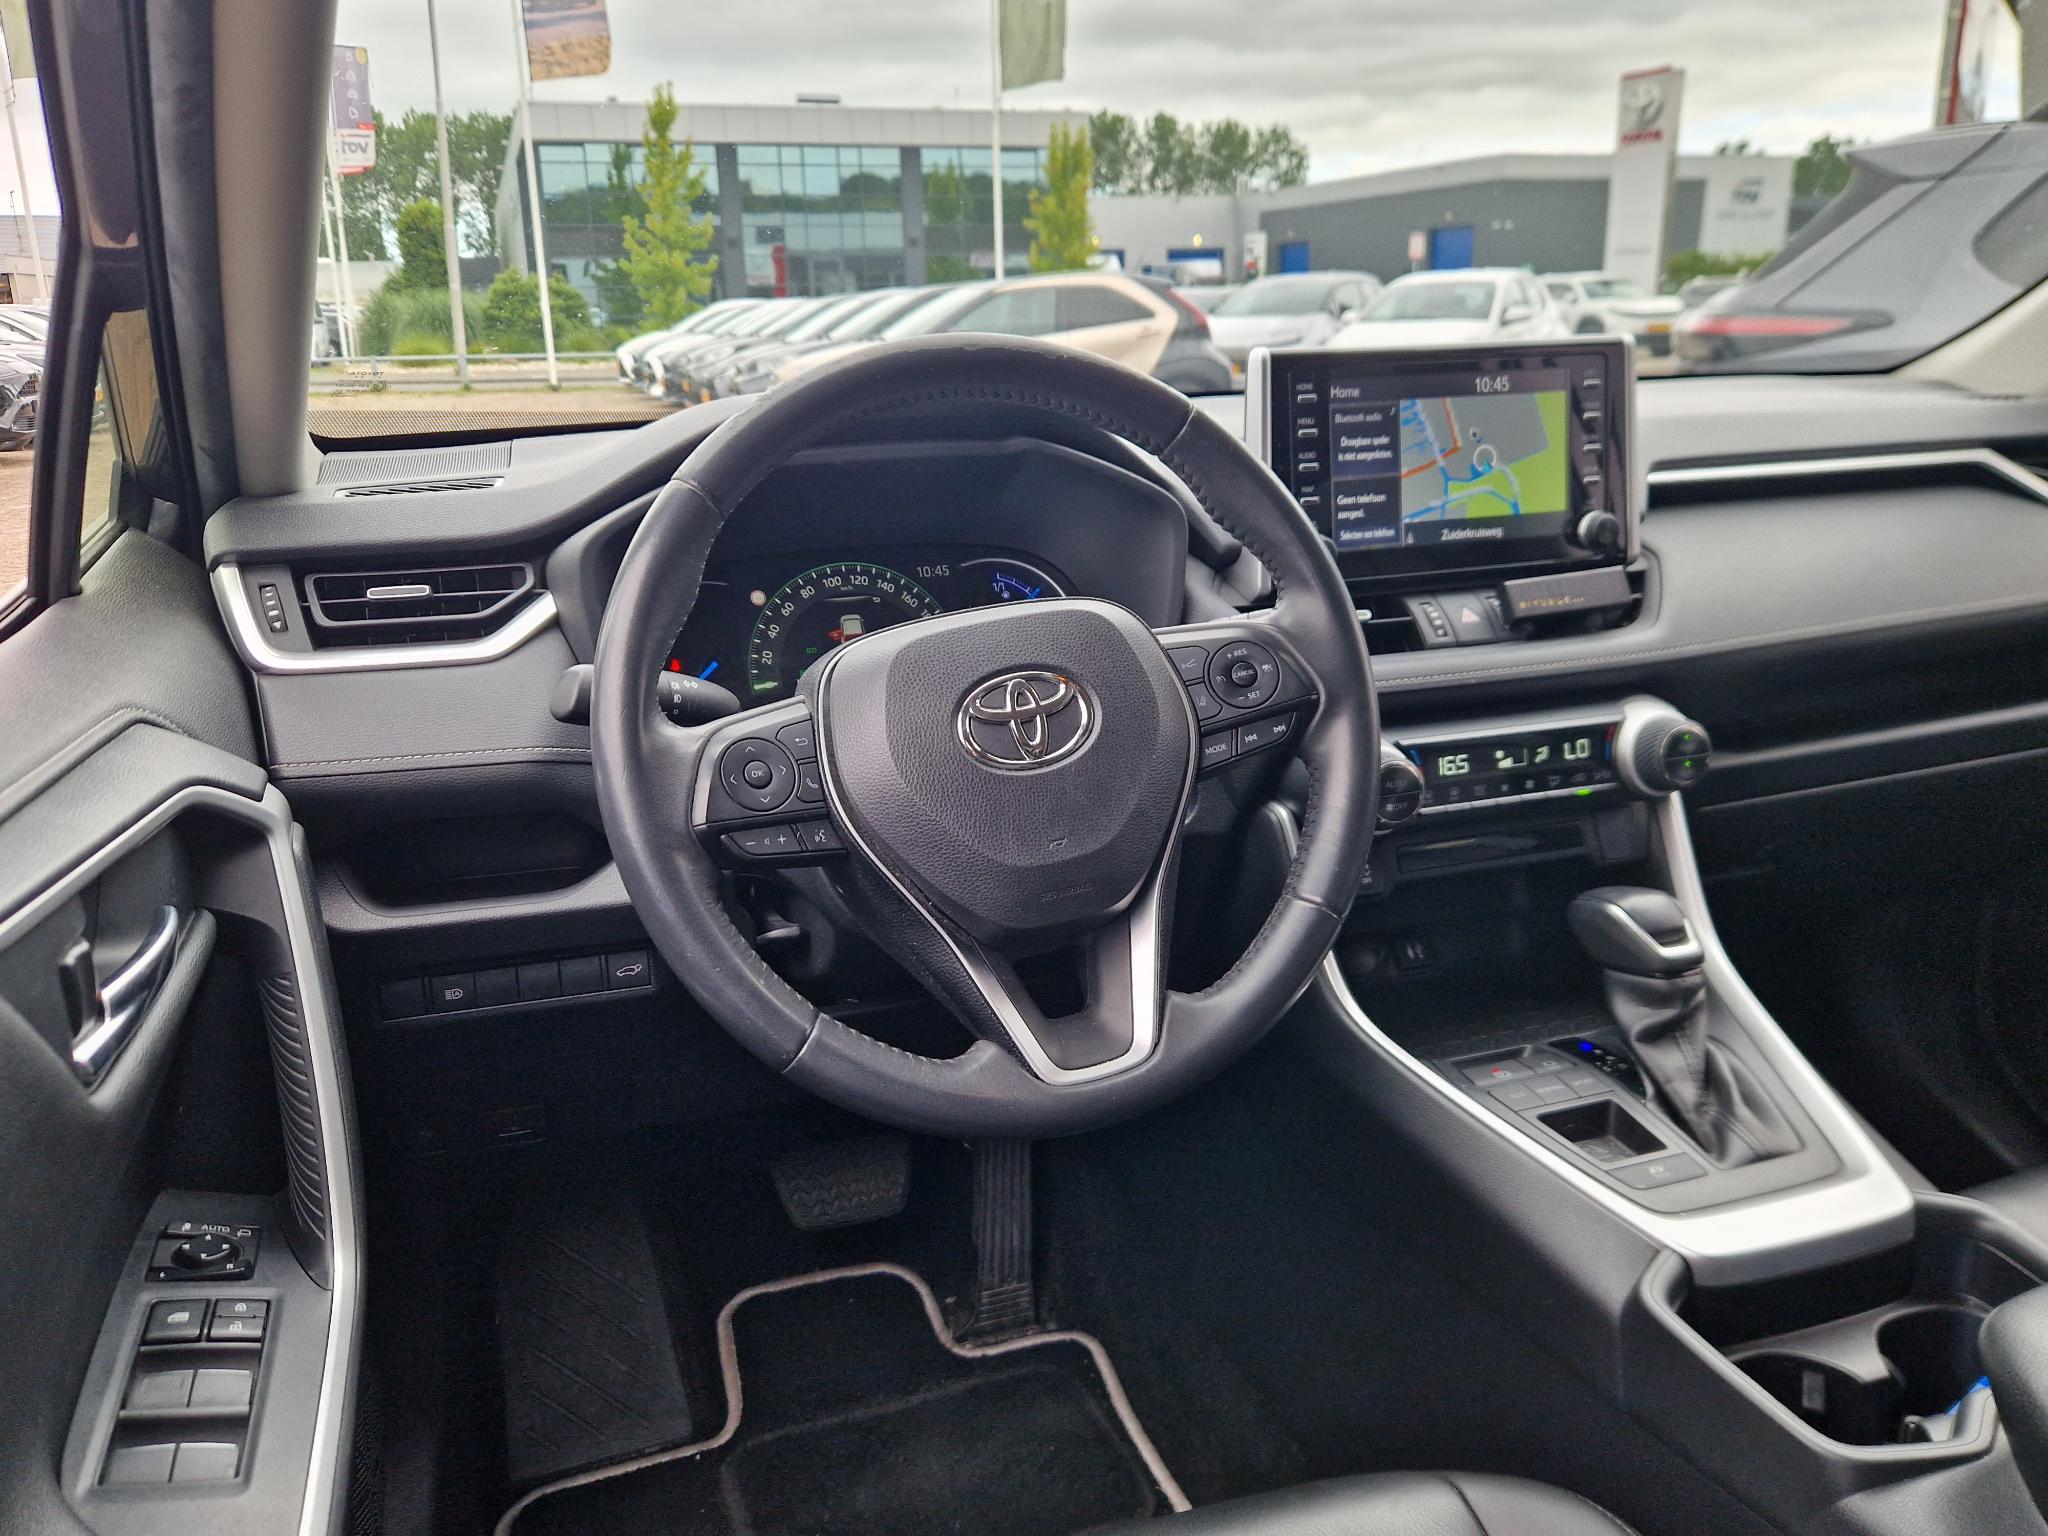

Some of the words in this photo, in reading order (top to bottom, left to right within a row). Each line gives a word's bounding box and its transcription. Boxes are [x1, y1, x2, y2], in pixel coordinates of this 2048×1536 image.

[1474, 375, 1510, 393] 10:45
[1330, 386, 1361, 398] Home
[1365, 411, 1382, 421] audio
[1298, 451, 1316, 459] AUDIO
[1336, 494, 1356, 505] Geen
[1356, 492, 1387, 504] telefoon
[1441, 527, 1504, 541] Zuiderkruisweg
[917, 564, 950, 577] 10:45
[822, 576, 842, 588] 100
[849, 575, 869, 586] 120
[877, 579, 895, 593] 140
[800, 585, 815, 599] 80
[901, 591, 918, 608] 160
[781, 602, 795, 617] 60
[767, 624, 780, 639] 40
[762, 650, 773, 665] 20
[1233, 669, 1256, 679] CANCEL
[1247, 690, 1261, 699] SET
[1205, 742, 1229, 755] MODE
[1562, 737, 1592, 760] LO
[751, 769, 765, 778] OK
[201, 1223, 231, 1233] AUTO
